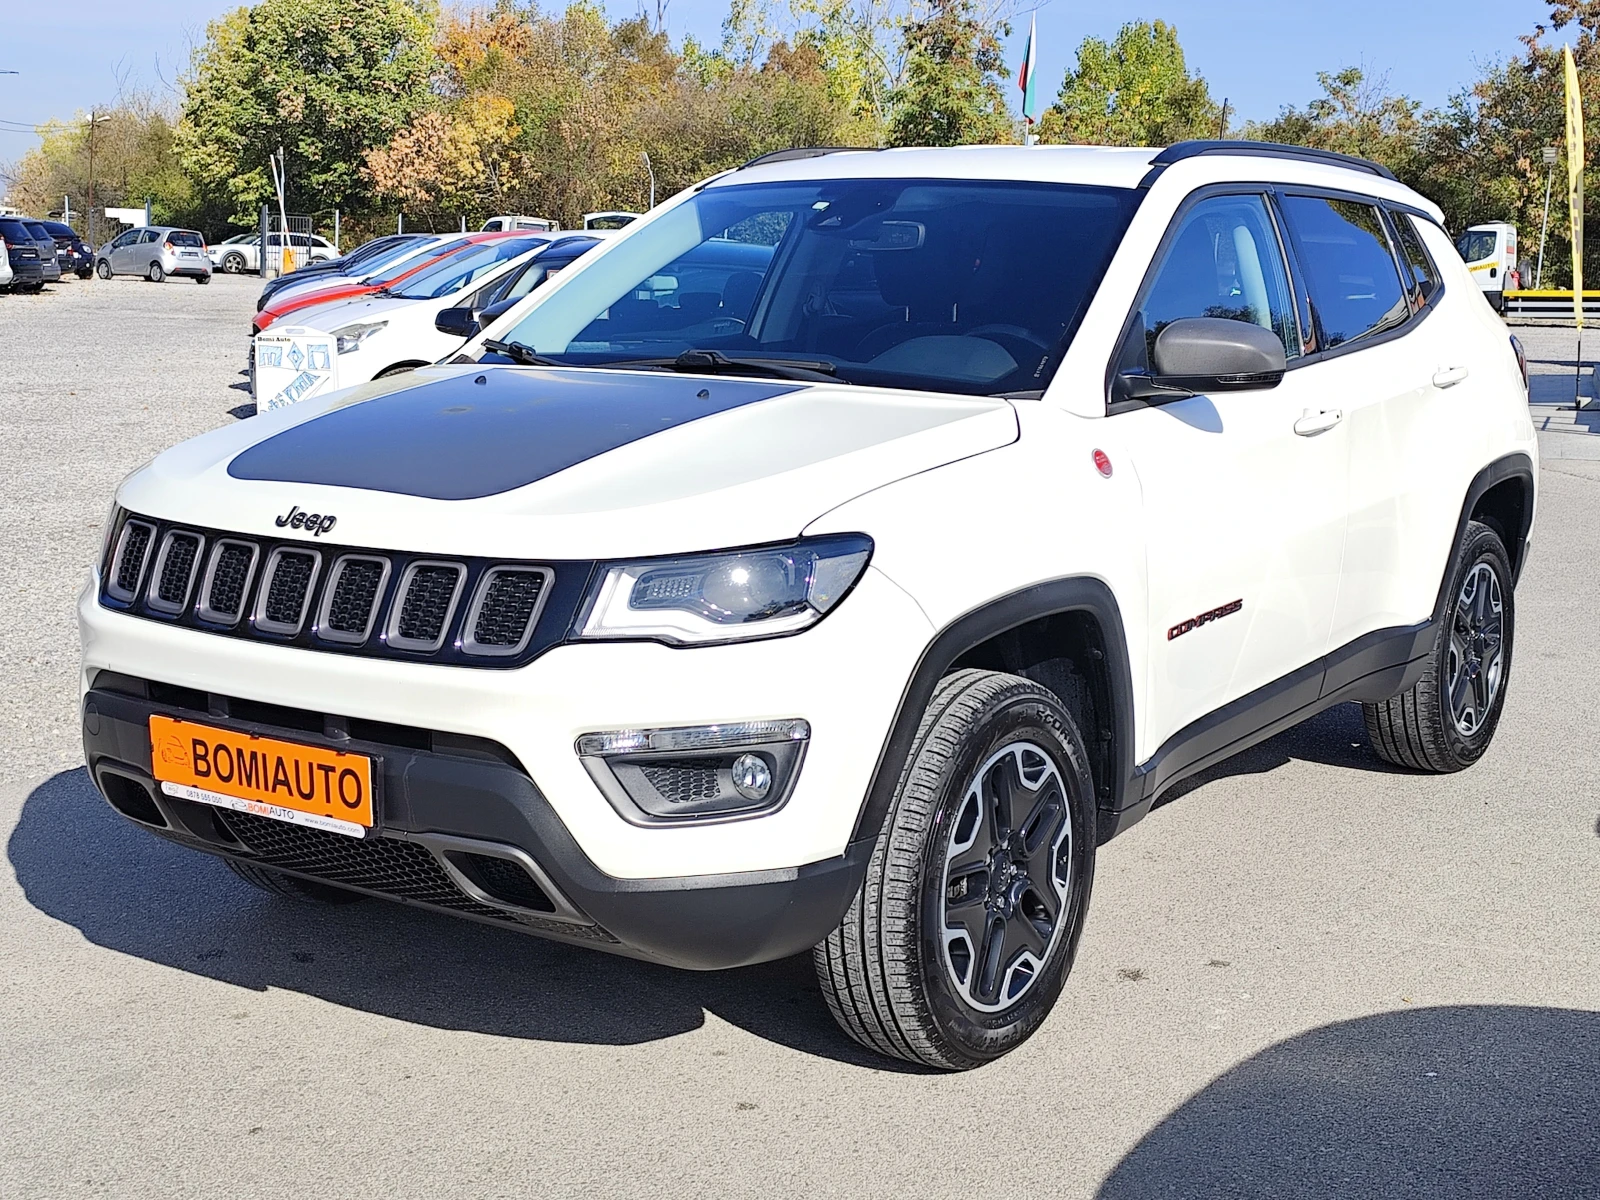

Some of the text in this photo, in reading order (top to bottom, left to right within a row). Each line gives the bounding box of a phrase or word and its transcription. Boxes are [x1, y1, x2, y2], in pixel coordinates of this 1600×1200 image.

[1469, 263, 1496, 272] OMIAUTO
[275, 506, 337, 537] Jeep
[1167, 598, 1243, 641] COMPASS
[192, 738, 362, 809] BOMIAUTO
[247, 803, 294, 820] BOMIAUTO
[304, 817, 361, 834] www.bomiauto.com
